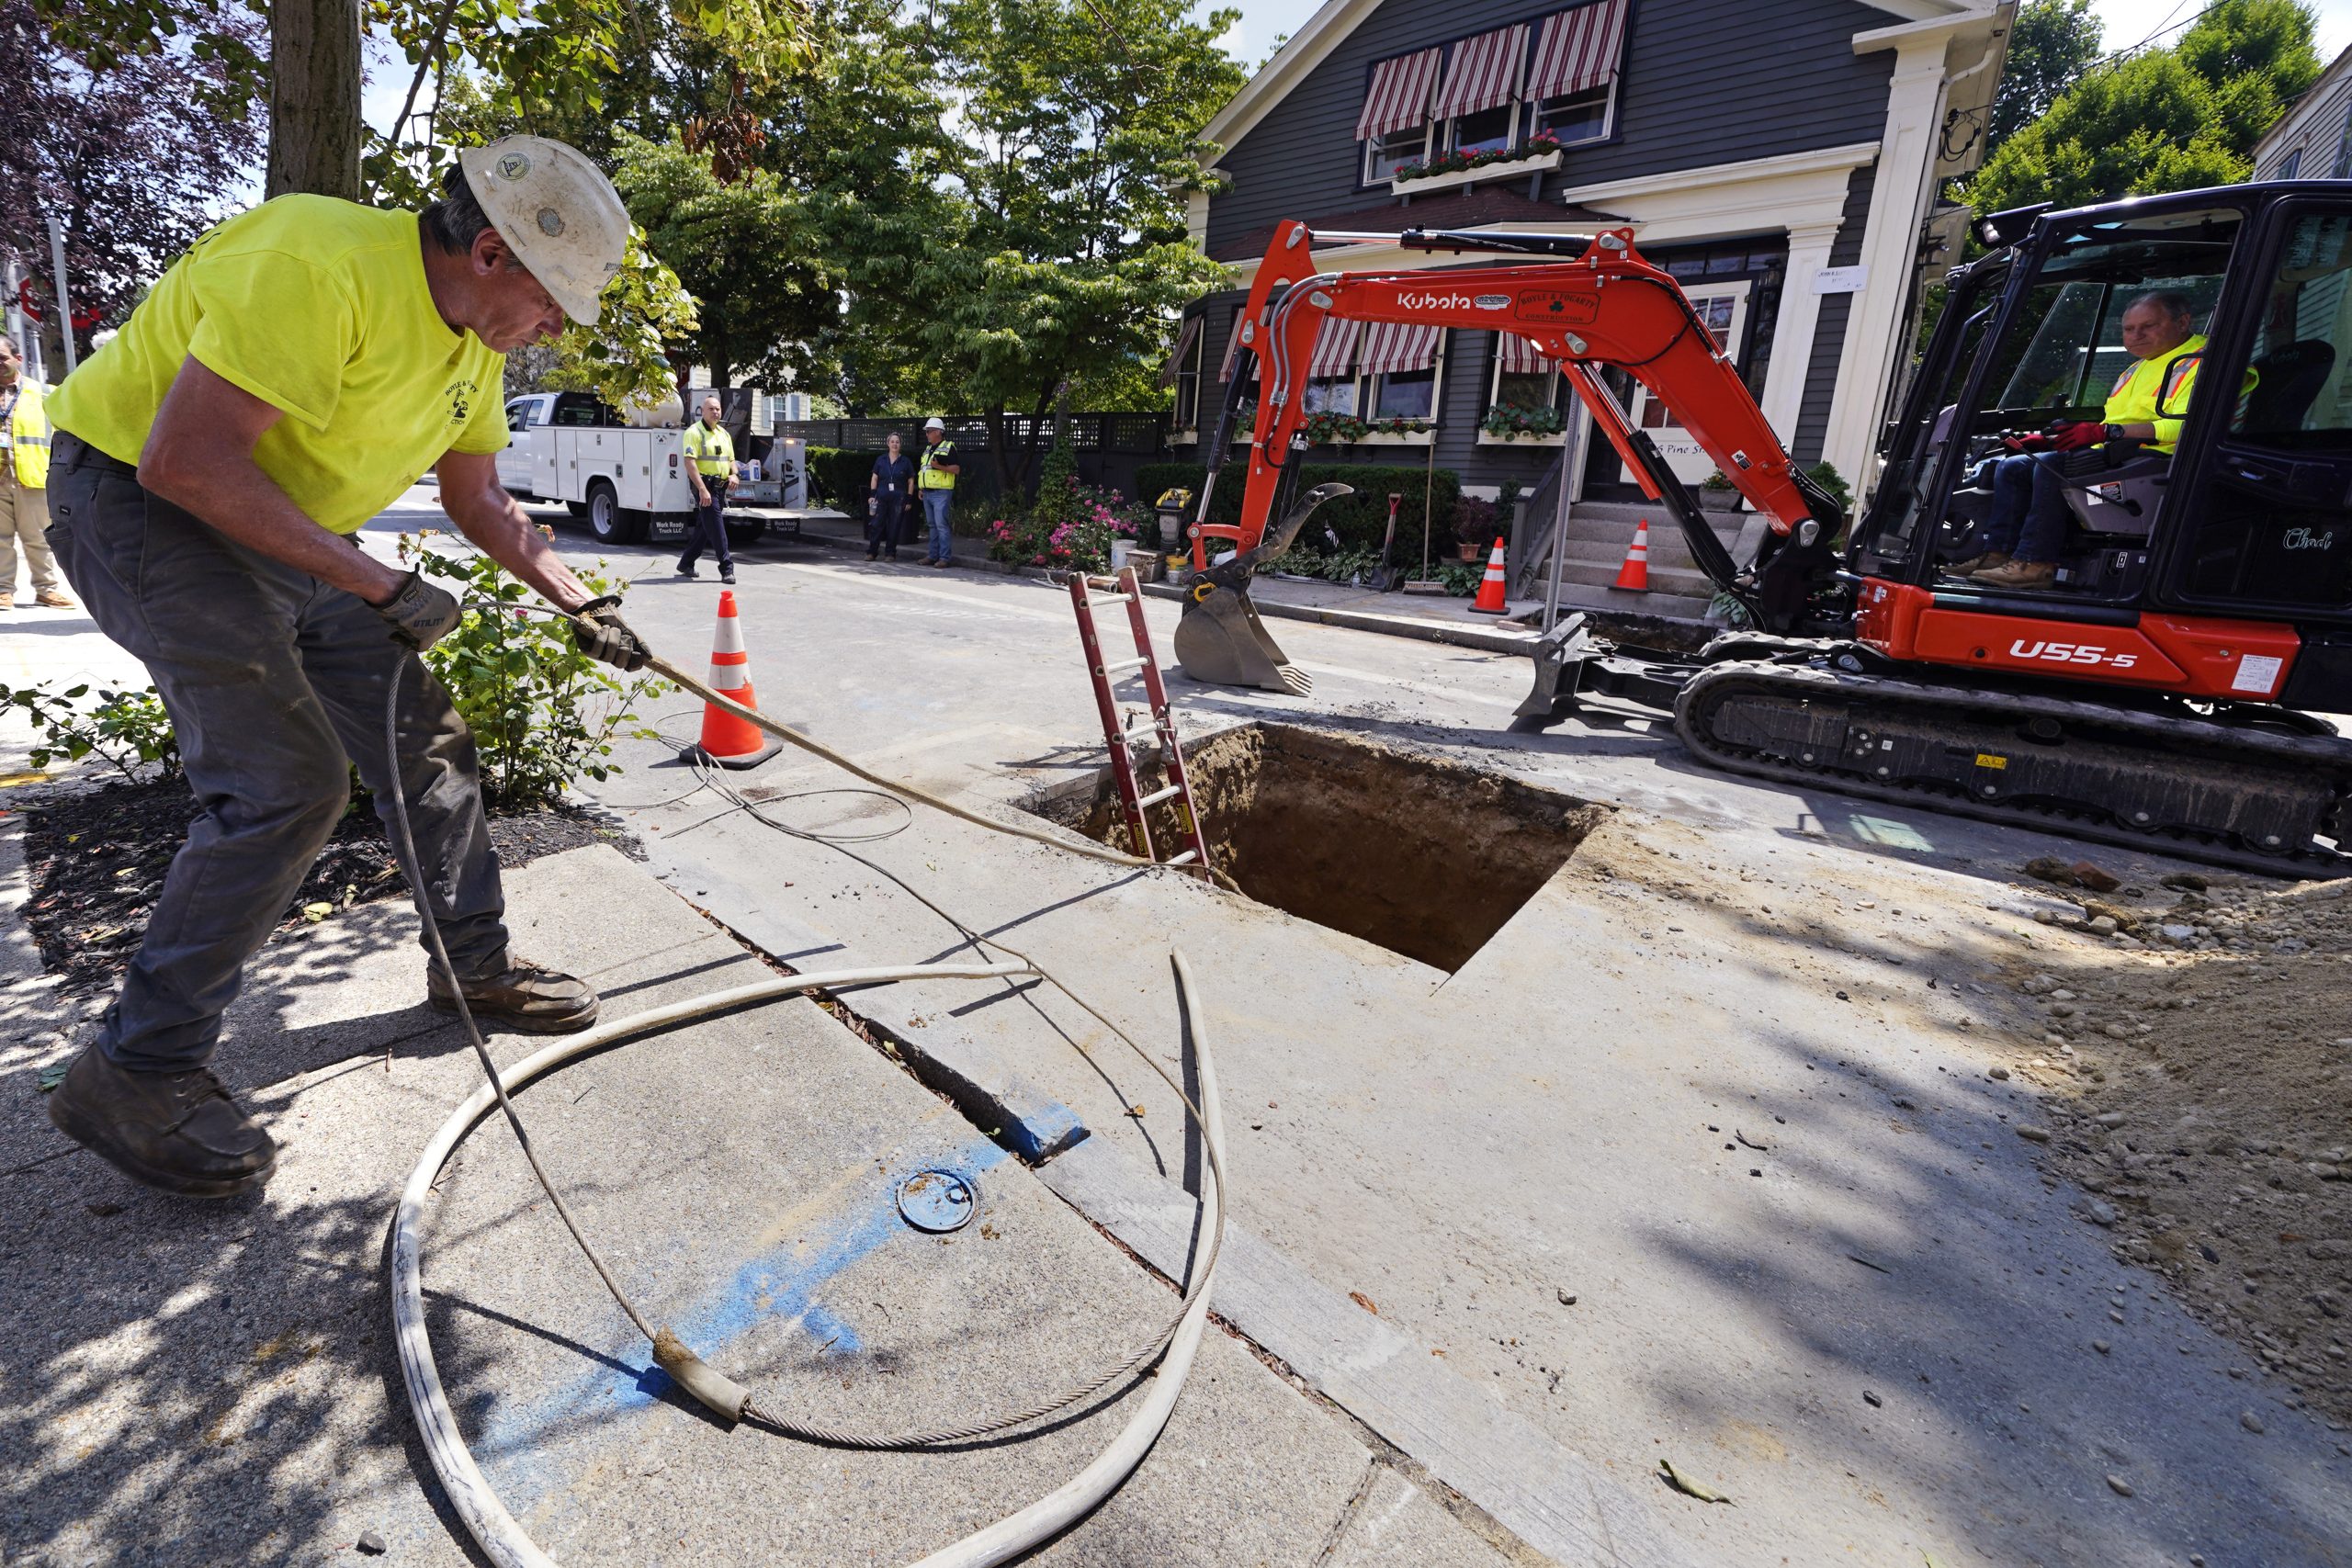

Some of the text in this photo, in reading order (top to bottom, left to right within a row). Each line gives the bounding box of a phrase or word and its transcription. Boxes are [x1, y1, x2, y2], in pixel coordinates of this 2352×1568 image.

[1397, 292, 1470, 310] Kubota
[1521, 293, 1546, 306] BOYLE
[1559, 293, 1597, 309] FOGARTY
[1525, 313, 1583, 321] CONSTRUCTION
[445, 381, 461, 396] BOYLE
[1667, 445, 1689, 454] Pine
[669, 521, 684, 529] Ready
[2283, 527, 2333, 550] Chad
[413, 617, 446, 627] UTILITY
[2009, 639, 2138, 668] U55-5
